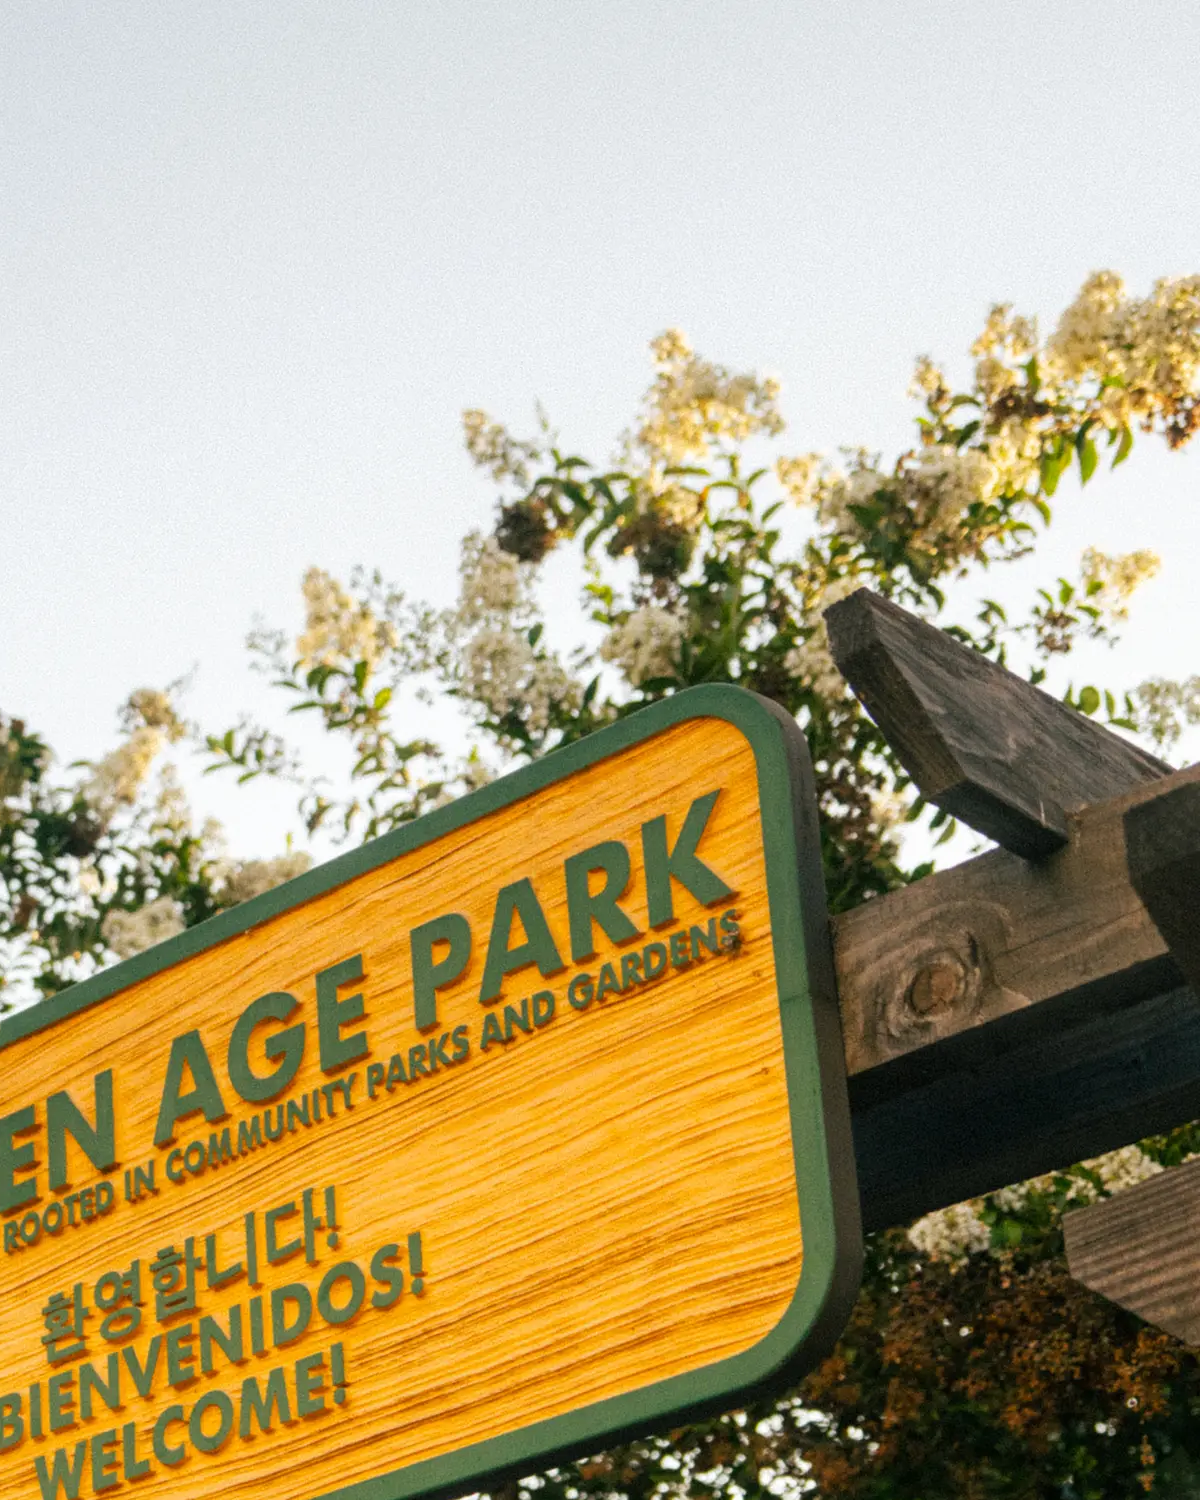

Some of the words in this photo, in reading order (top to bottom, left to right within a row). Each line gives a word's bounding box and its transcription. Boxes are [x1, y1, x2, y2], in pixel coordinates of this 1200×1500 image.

[3, 1183, 114, 1253] ROOTED
[124, 1160, 156, 1202] IN
[165, 1073, 357, 1182] COMMUNITY
[366, 1025, 470, 1098] PARKS
[479, 990, 556, 1049] AND
[567, 909, 741, 1010] GARDENS
[153, 954, 369, 1147] AGE
[409, 788, 738, 1031] PARK
[41, 1185, 339, 1365] 환영합니다!
